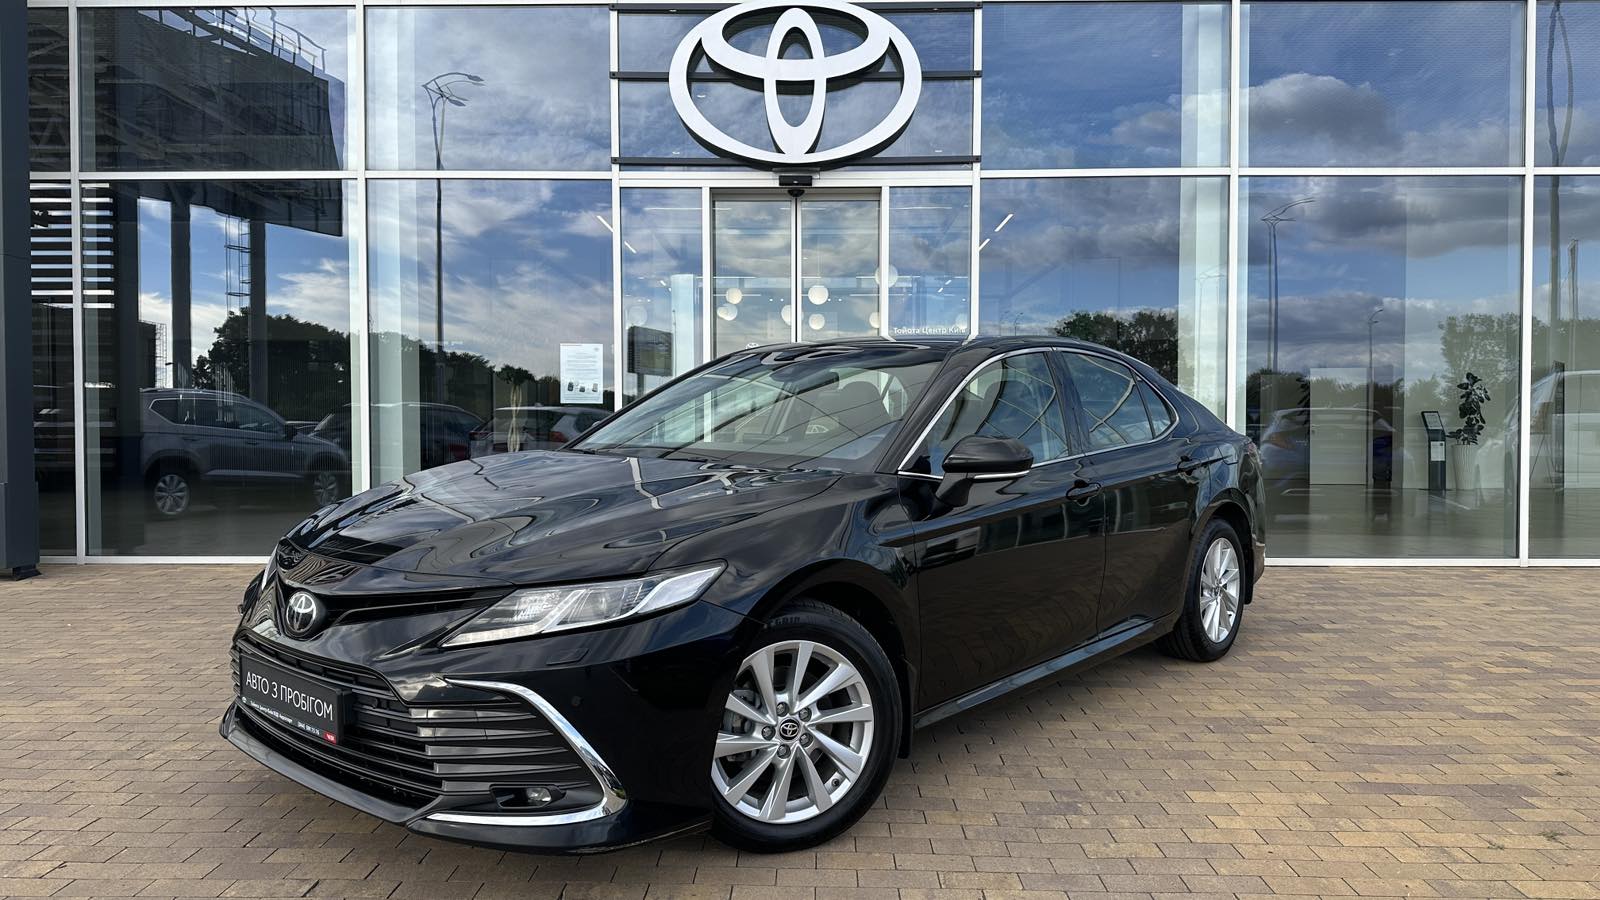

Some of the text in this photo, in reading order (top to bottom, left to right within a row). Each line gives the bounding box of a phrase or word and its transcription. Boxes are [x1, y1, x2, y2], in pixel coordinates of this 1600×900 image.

[894, 326, 920, 334] Тойота
[922, 327, 947, 335] Центр
[246, 671, 269, 695] АВТО
[280, 684, 333, 721] ПРОБІГОМ
